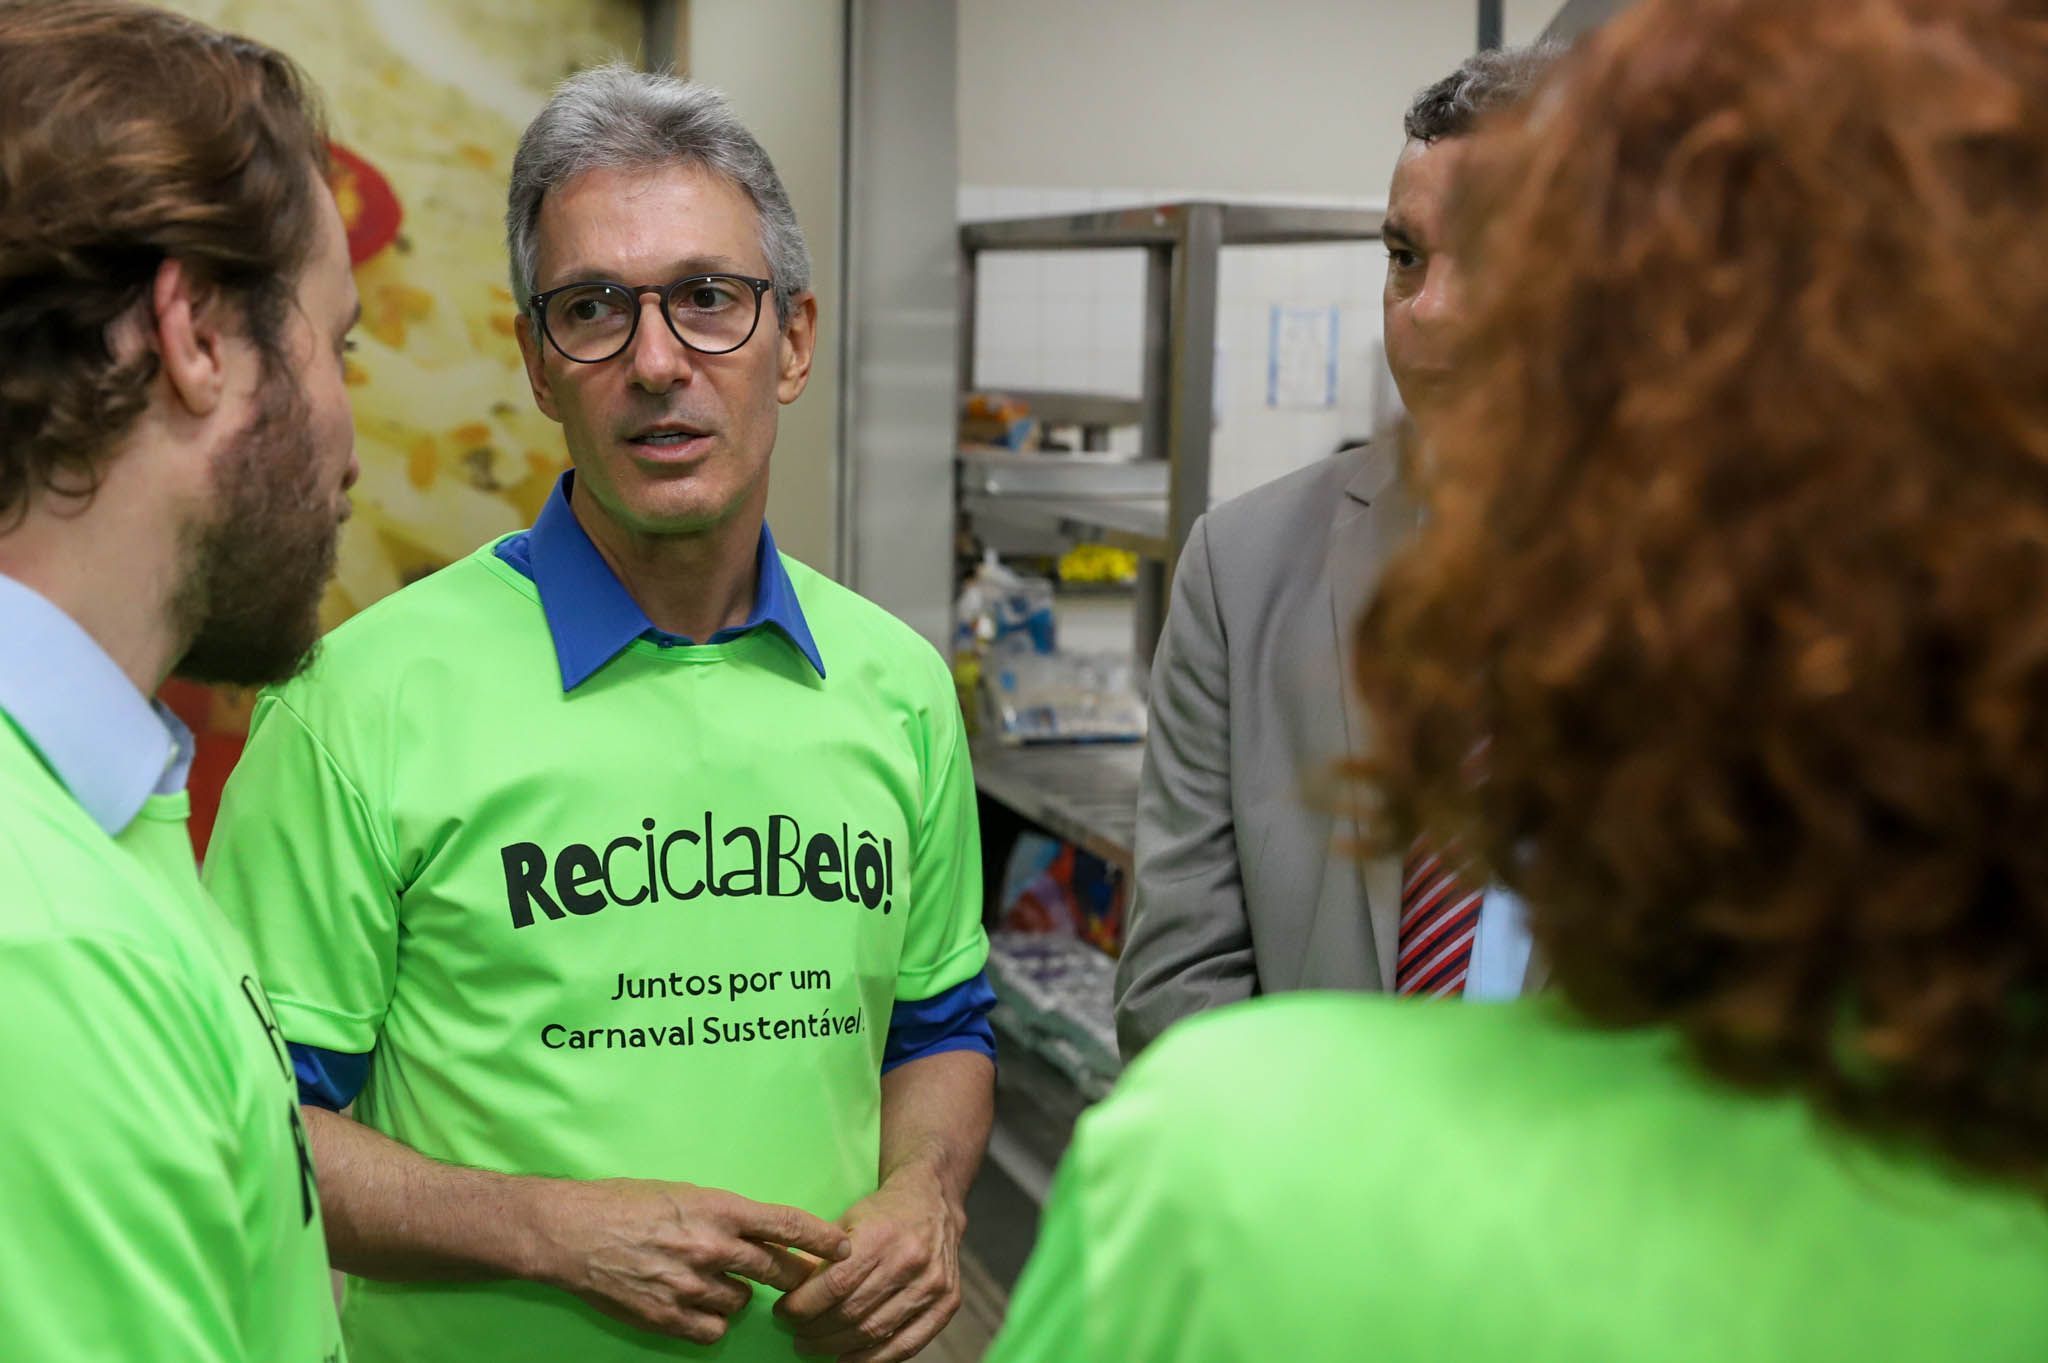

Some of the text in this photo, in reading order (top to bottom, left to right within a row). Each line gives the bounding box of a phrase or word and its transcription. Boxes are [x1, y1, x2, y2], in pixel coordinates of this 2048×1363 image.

[611, 968, 832, 1001] Juntos por um
[541, 1017, 694, 1049] Carnaval
